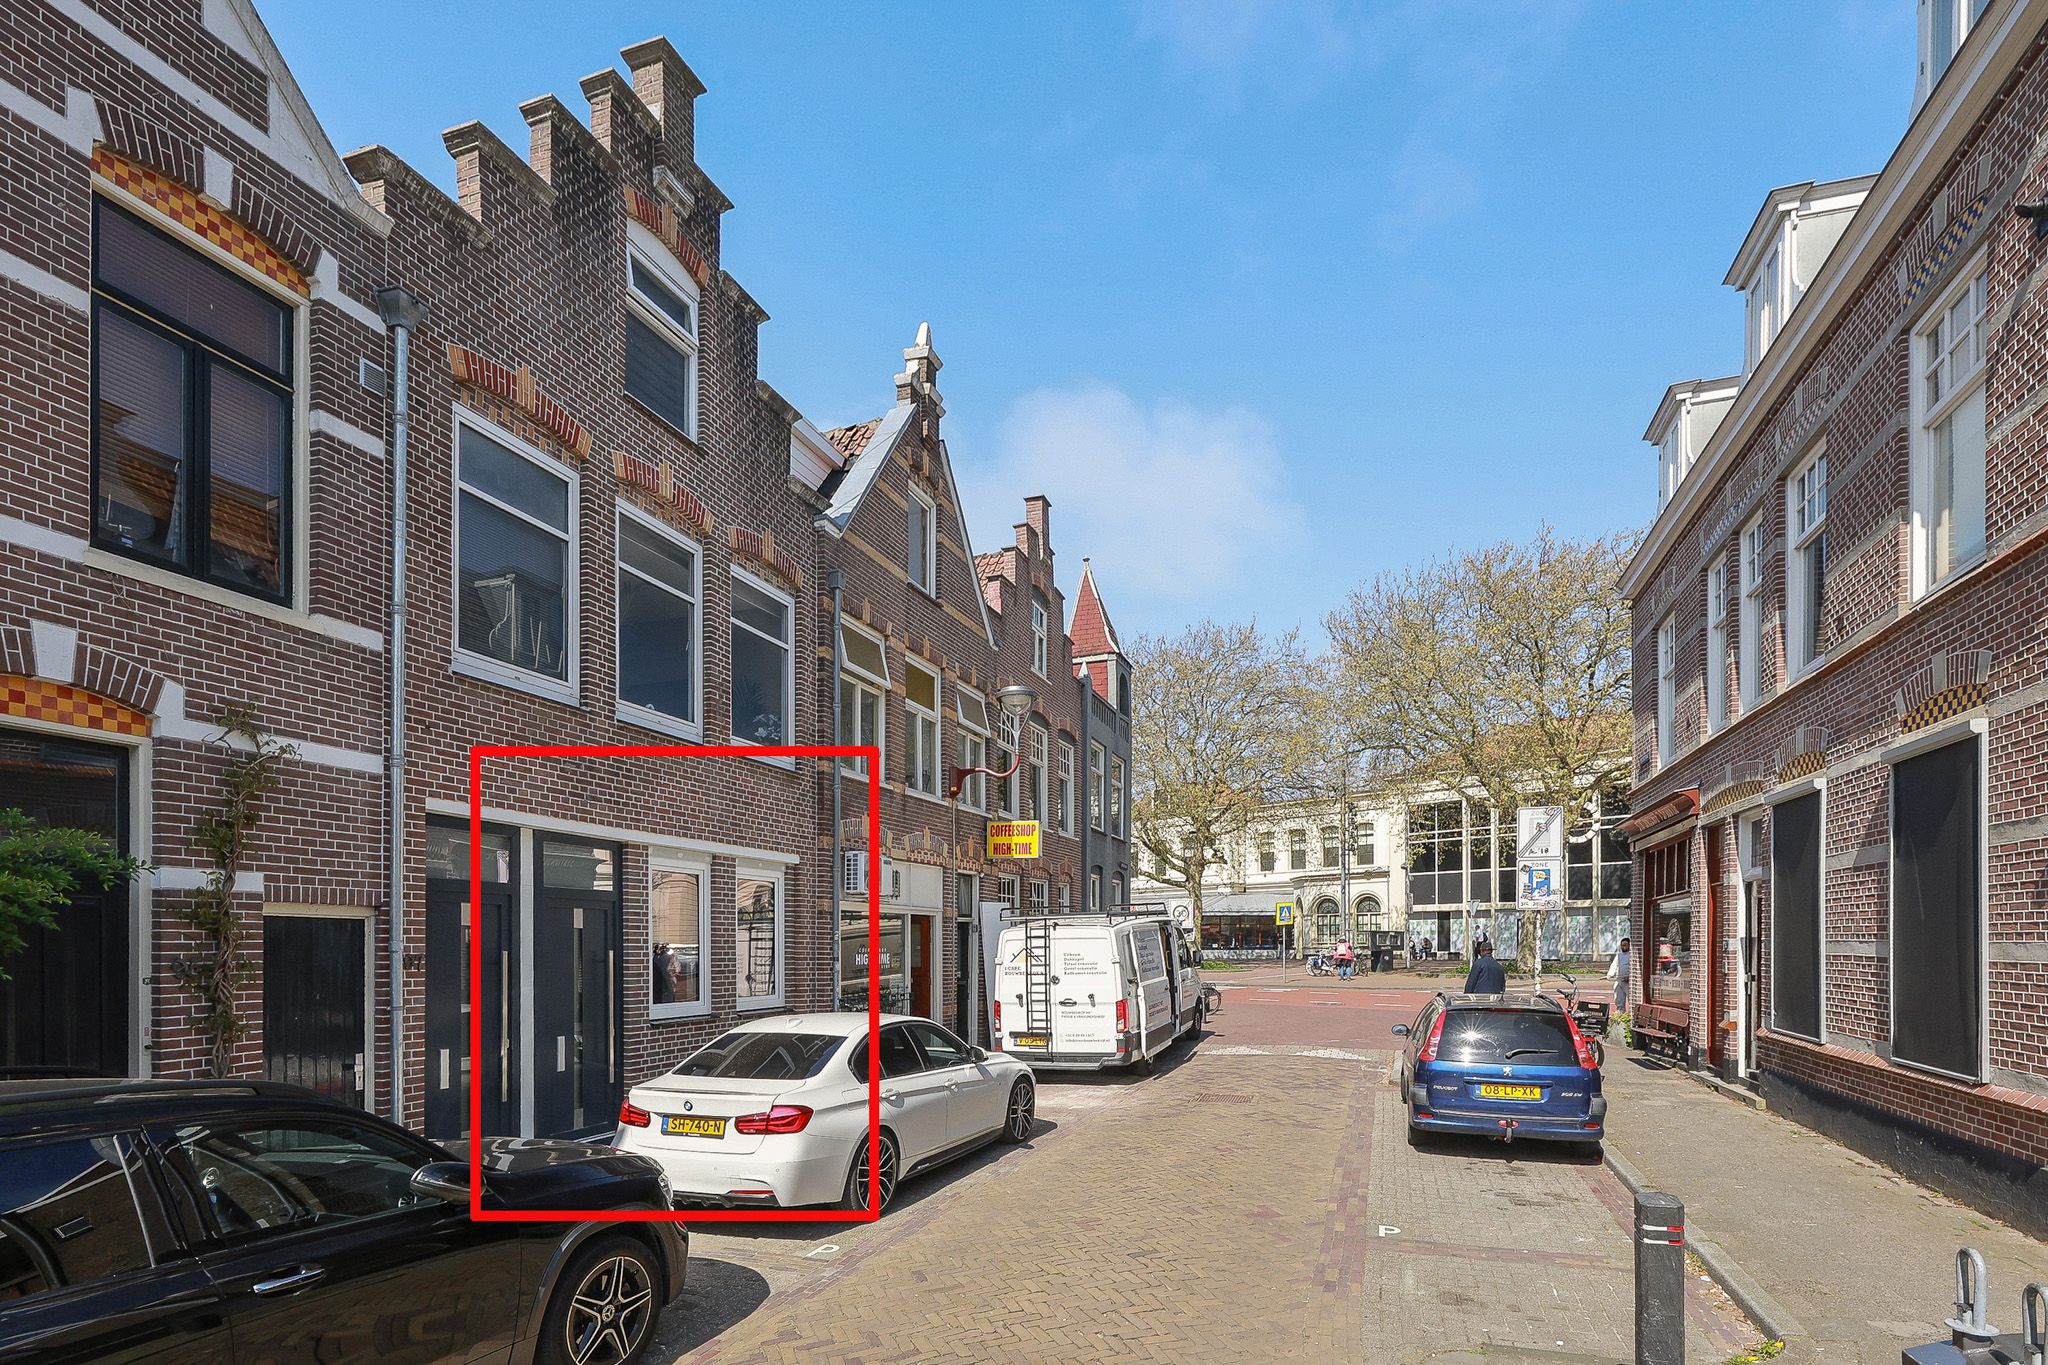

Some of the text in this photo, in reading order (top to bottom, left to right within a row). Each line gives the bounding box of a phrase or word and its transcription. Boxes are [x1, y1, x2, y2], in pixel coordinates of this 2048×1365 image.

[990, 824, 1036, 837] COFFEESHOP
[993, 842, 1032, 855] HIGH-TIME
[1484, 1085, 1536, 1097] 08-LP-XK
[671, 1118, 722, 1133] SH-740-N
[1379, 1225, 1402, 1237] P
[804, 1244, 840, 1257] P
